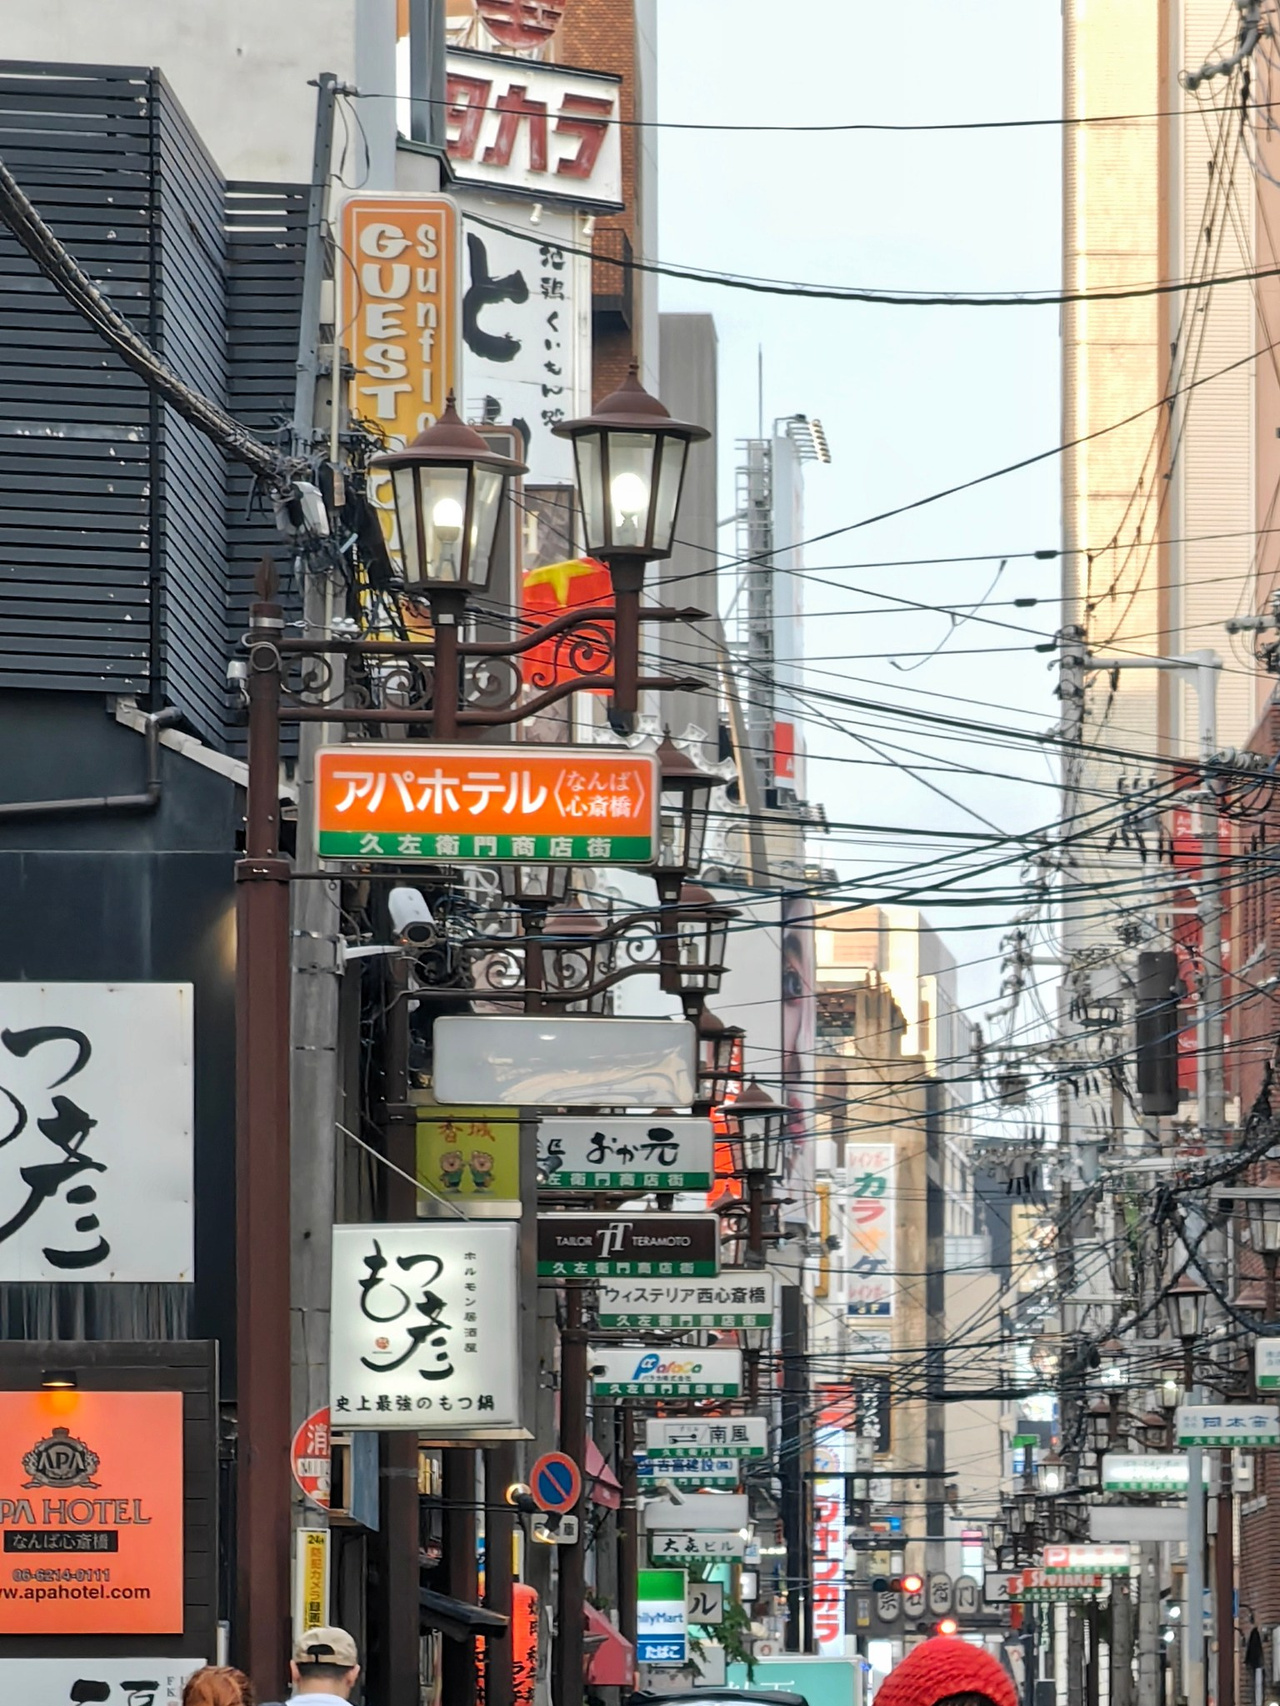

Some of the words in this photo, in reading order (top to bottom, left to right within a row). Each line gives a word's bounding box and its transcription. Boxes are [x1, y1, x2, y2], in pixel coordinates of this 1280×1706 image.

[359, 222, 413, 420] GUEST
[332, 768, 548, 816] アパホテル
[566, 770, 632, 793] なんば
[564, 794, 633, 819] 心斎橋
[359, 832, 613, 858] 久左衛門商店街
[0, 1026, 111, 1270] つ彦
[555, 1236, 593, 1247] TAILOR
[632, 1236, 692, 1247] TERAMOTO
[552, 1261, 695, 1275] 久左衛門商店街
[463, 1251, 478, 1353] ホルモン居酒屋
[604, 1286, 767, 1304] ウィステリア西心斎橋
[335, 1394, 495, 1413] 史上最強のもつ鍋
[709, 1424, 749, 1443] 南風
[43, 1499, 153, 1525] HOTEL
[13, 1534, 109, 1550] なんば心斎橋
[13, 1568, 111, 1582] 06-6214-0111
[645, 1645, 681, 1660] たばこ
